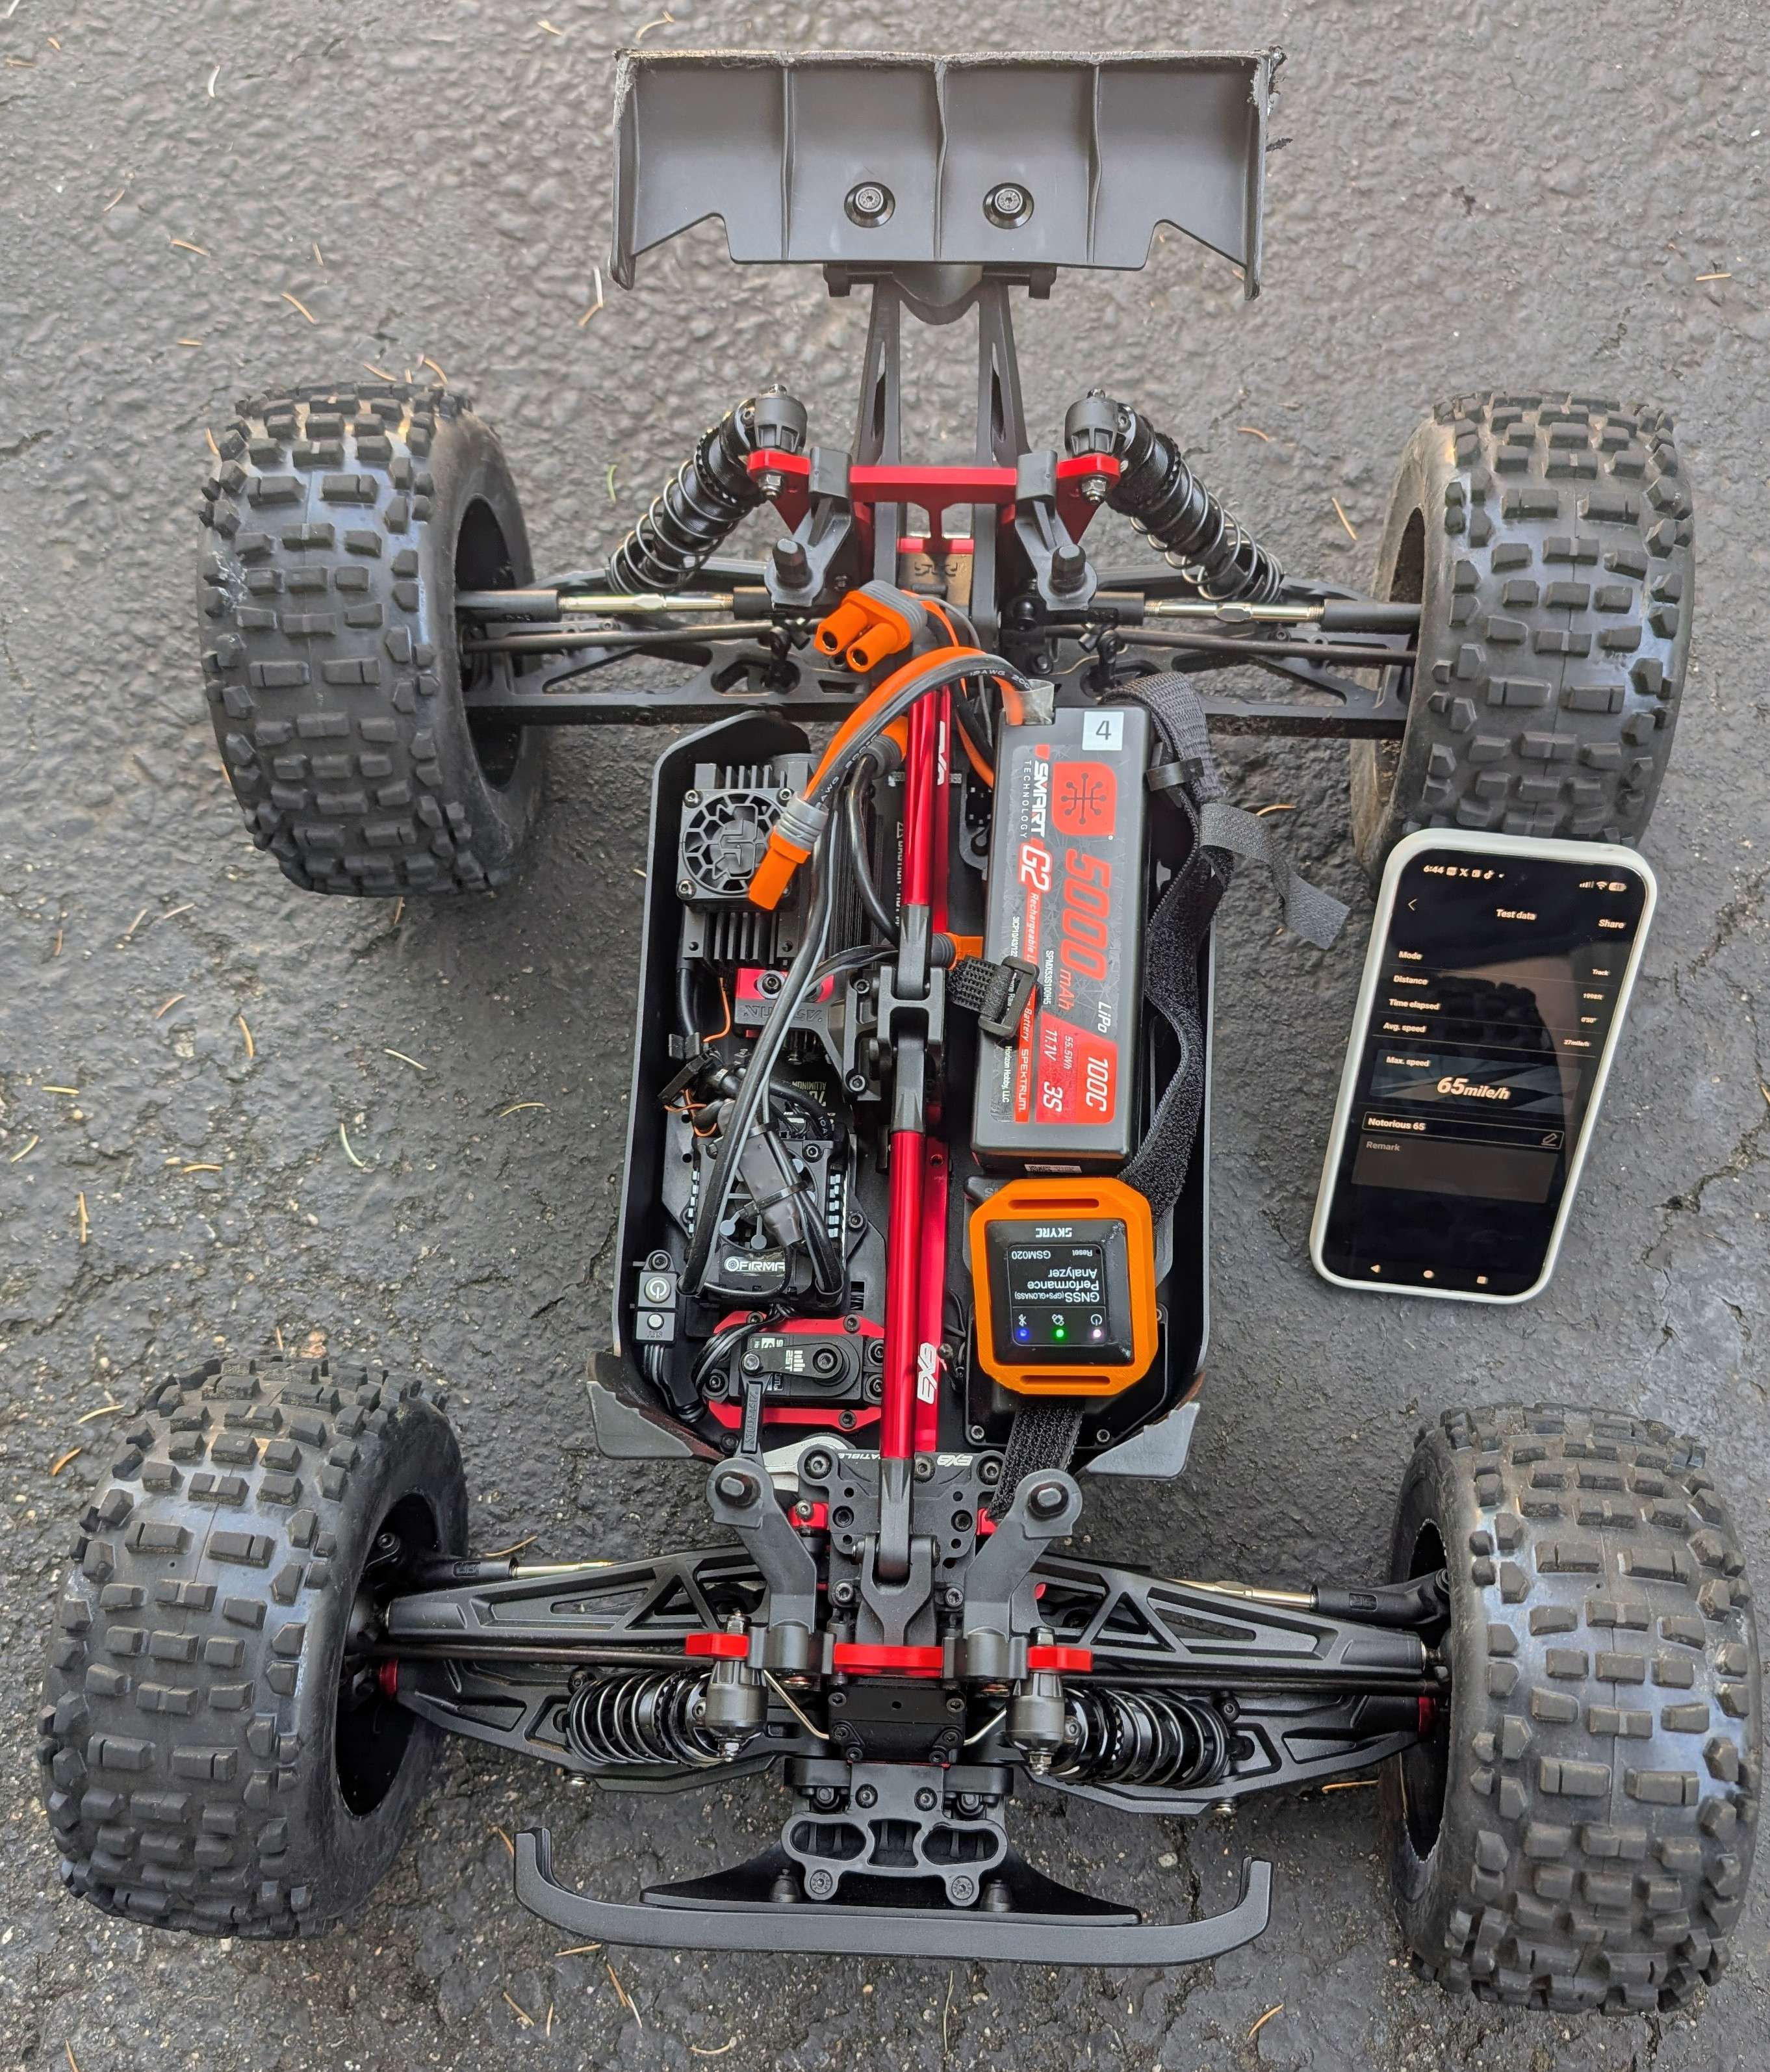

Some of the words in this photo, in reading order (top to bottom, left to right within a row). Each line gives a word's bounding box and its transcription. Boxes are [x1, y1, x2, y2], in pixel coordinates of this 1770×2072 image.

[1096, 720, 1112, 740] 4
[1020, 760, 1032, 838] TECHNOLOGY
[1031, 760, 1049, 838] SMART
[1021, 844, 1051, 891] G2
[1424, 865, 1444, 874] 6:44
[1027, 892, 1040, 953] Rechargeable
[1061, 849, 1111, 980] 5000
[1496, 909, 1515, 919] Test
[1517, 911, 1536, 920] data
[1598, 920, 1625, 929] Share
[1398, 951, 1422, 961] Mode
[1043, 950, 1054, 1005] SPMX53S100H5
[1393, 976, 1429, 986] Distance
[1058, 968, 1074, 1012] mAh
[1389, 998, 1409, 1008] Time
[1409, 1001, 1440, 1011] elapsed
[1023, 1007, 1033, 1041] Battery
[1097, 1001, 1112, 1033] LiPo
[1383, 1022, 1401, 1032] Avg.
[1403, 1024, 1427, 1035] speed
[1044, 1030, 1058, 1061] 11.1V
[1064, 1035, 1073, 1069] 55.5Wh
[1387, 1056, 1405, 1065] Max.
[1407, 1058, 1430, 1068] speed
[1086, 1056, 1109, 1112] 100C
[1437, 1076, 1511, 1100] 65mile/h
[1043, 1081, 1063, 1113] 3S
[1368, 1118, 1411, 1130] Notorious
[1413, 1121, 1426, 1131] 65
[1366, 1141, 1400, 1152] Remark
[1036, 1227, 1072, 1237] SKYRC
[1012, 1250, 1051, 1260] GSM020
[739, 1261, 786, 1271] FIRMA
[1047, 1267, 1097, 1279] Analyzer
[1027, 1280, 1099, 1291] Performance
[1065, 1292, 1099, 1302] GNSS
[785, 1350, 793, 1372] 25T
